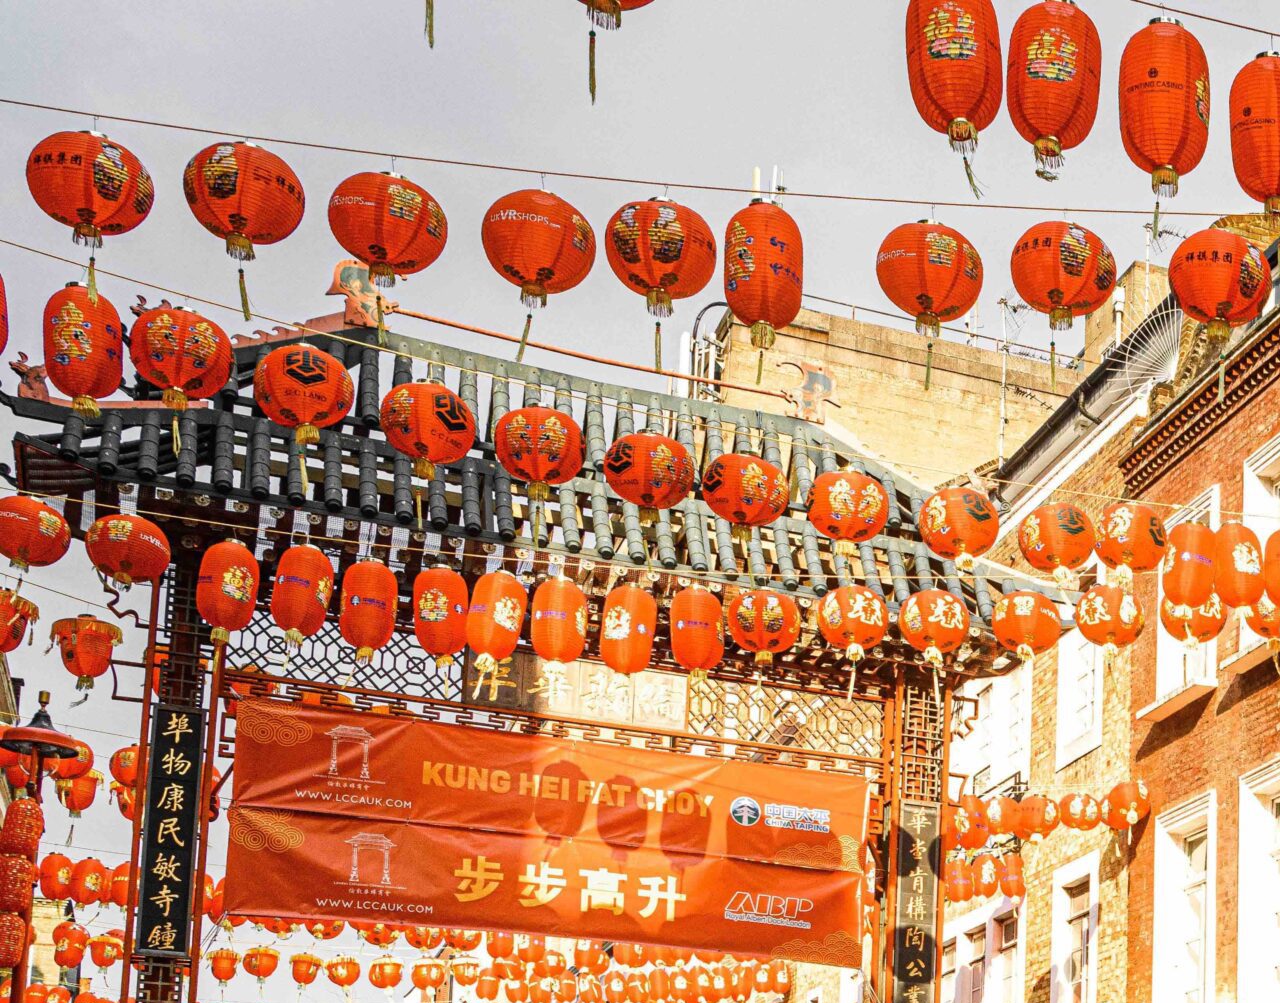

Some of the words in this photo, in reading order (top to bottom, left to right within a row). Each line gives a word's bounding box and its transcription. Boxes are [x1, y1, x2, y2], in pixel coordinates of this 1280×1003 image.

[295, 789, 412, 809] WWW.LCCAUK.COM
[421, 761, 511, 794] KUNG
[518, 772, 570, 801] HEI
[577, 780, 631, 808] FAT
[636, 787, 714, 817] CHOY
[765, 804, 830, 823] 中国太平
[147, 711, 194, 950] 埠物康民敏寺鐘
[765, 819, 792, 829] CHINA
[794, 822, 829, 833] TAIPING
[454, 855, 687, 922] 步步高升
[316, 898, 433, 914] WWW.LCCAUK.COM
